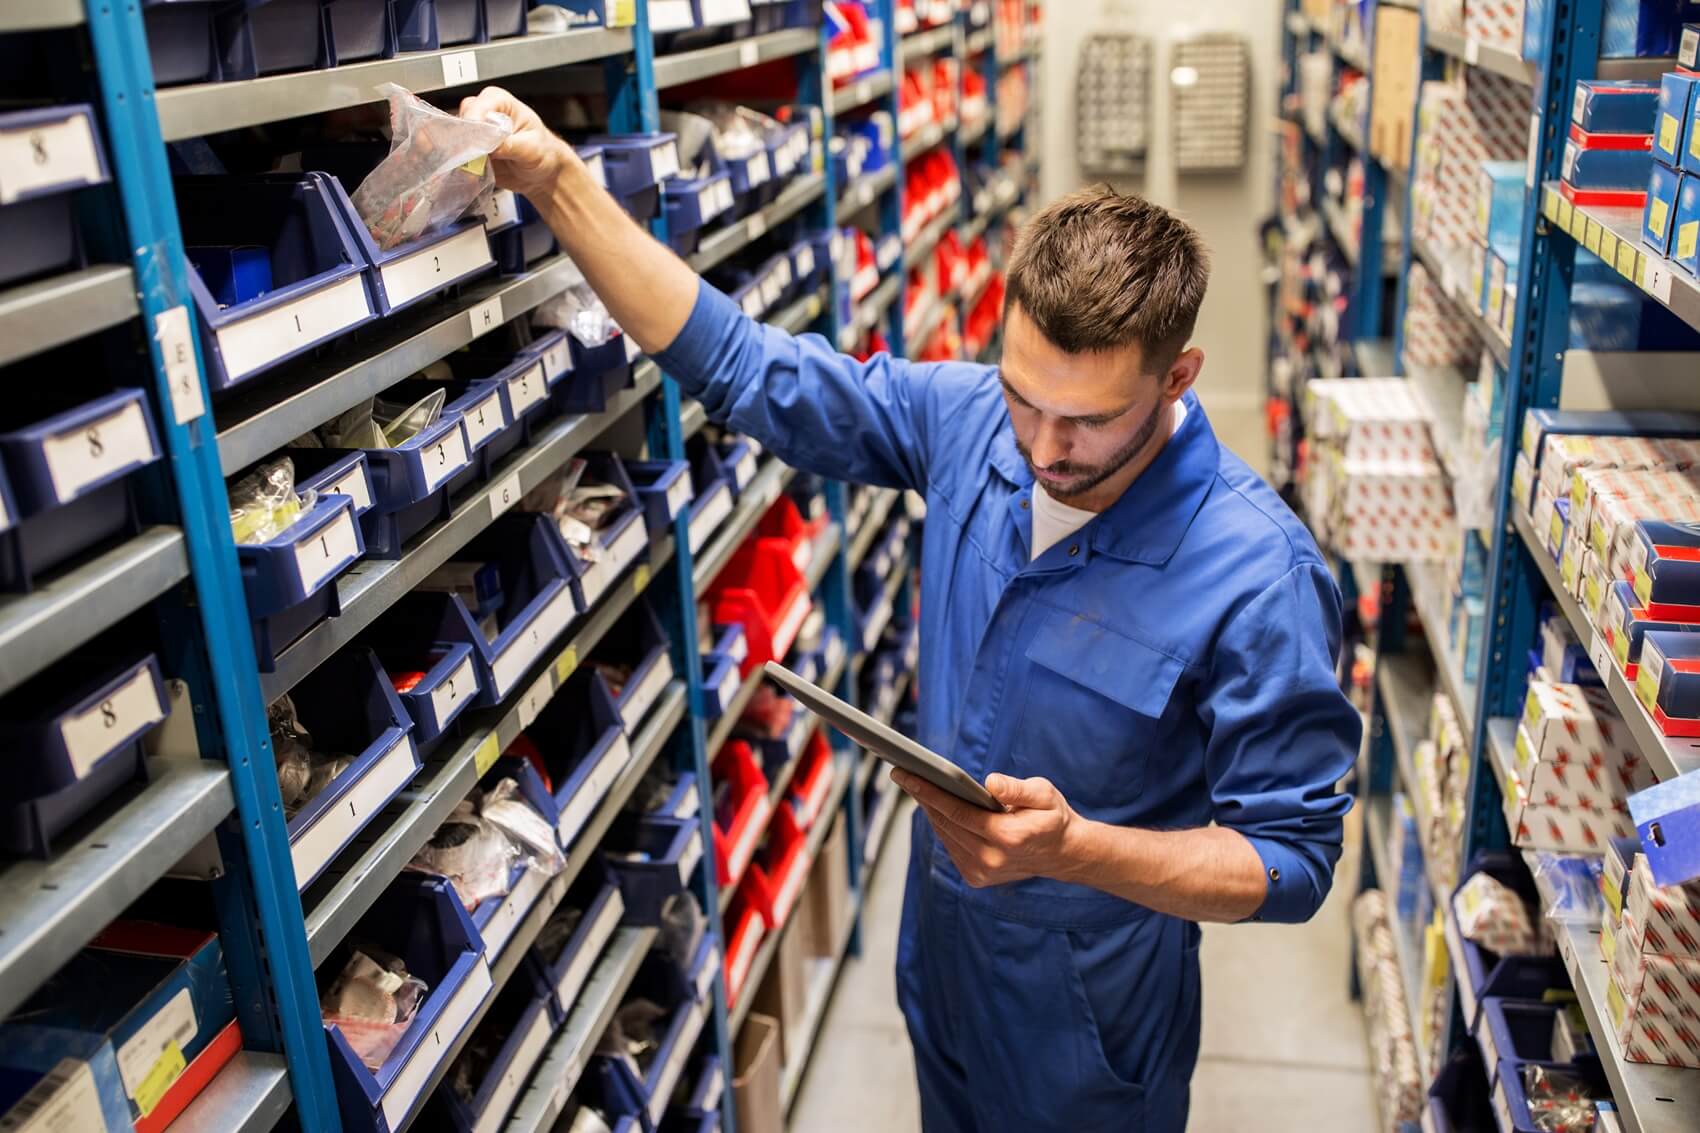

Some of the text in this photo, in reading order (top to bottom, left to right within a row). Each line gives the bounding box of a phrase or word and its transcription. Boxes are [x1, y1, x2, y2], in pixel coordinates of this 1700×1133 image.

[29, 129, 48, 167] 8
[433, 256, 441, 273] 2
[482, 309, 491, 326] H
[477, 407, 485, 427] 4
[86, 425, 104, 459] 8
[438, 444, 446, 466] 3
[502, 488, 509, 504] G
[448, 679, 457, 700] 2
[100, 699, 117, 729] 8
